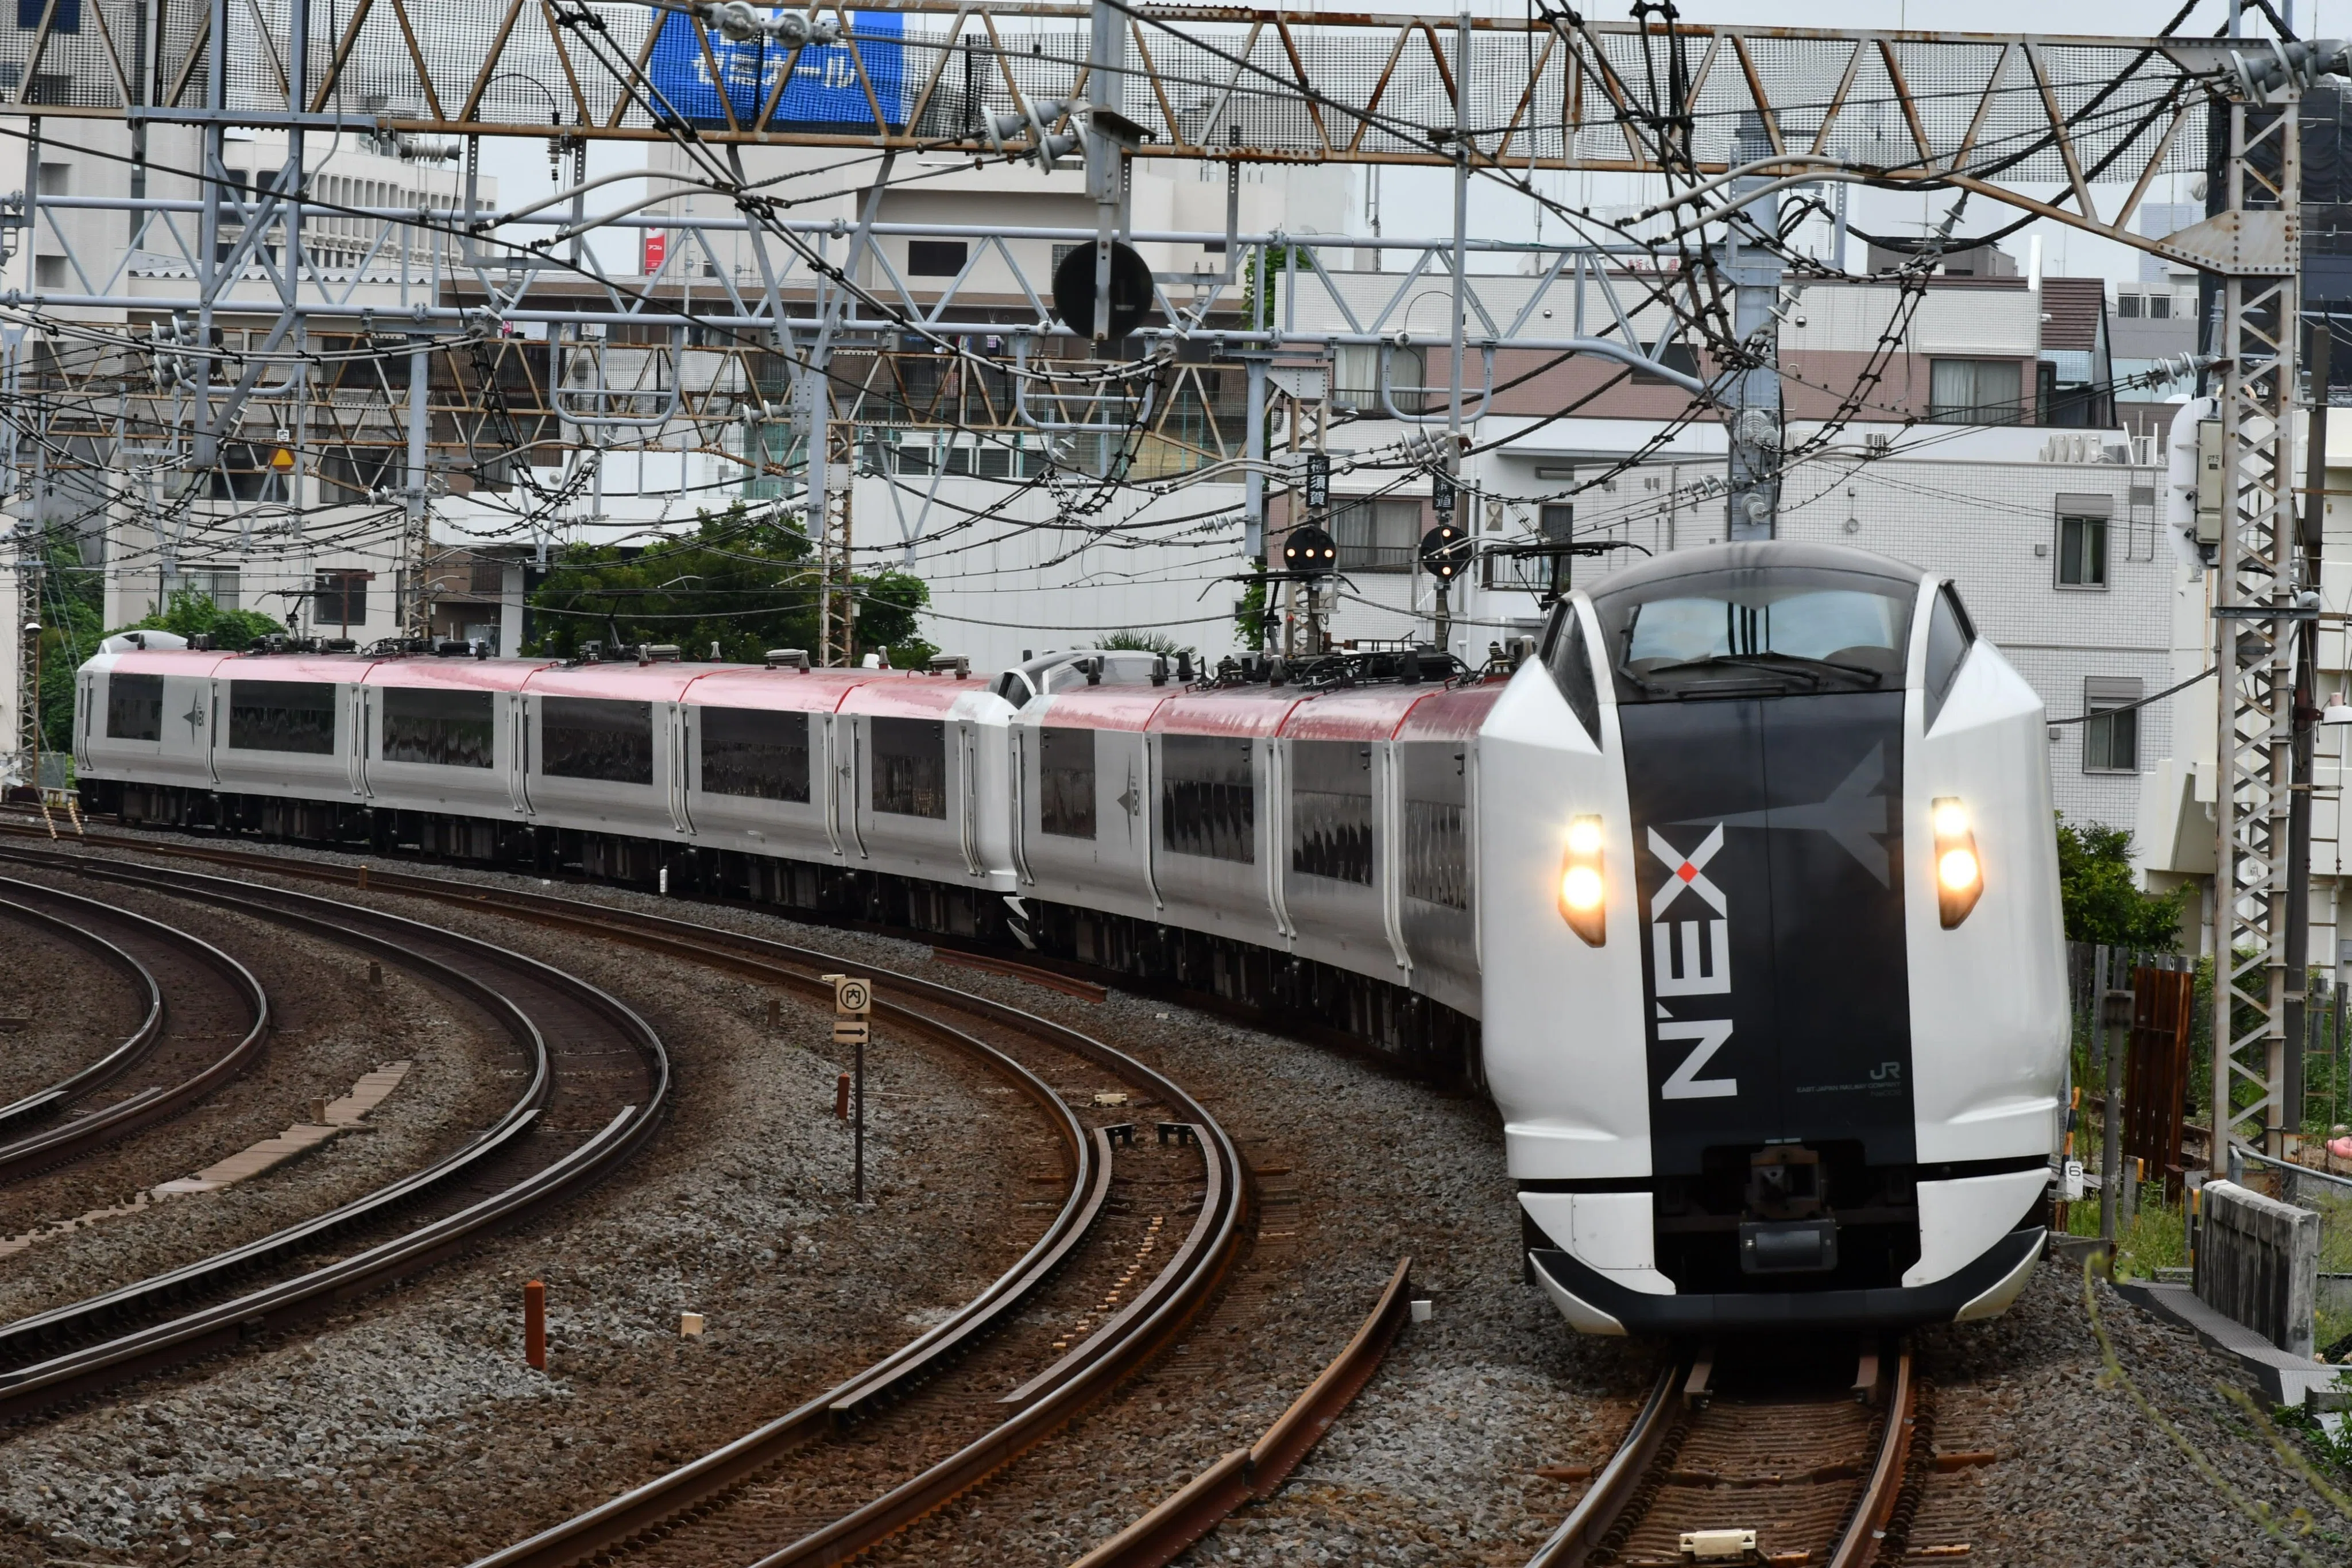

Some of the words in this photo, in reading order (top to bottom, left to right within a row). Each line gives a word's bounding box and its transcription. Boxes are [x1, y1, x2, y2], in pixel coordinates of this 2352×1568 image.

[1870, 1061, 1901, 1080] JR
[1867, 1081, 1901, 1089] COMPANY
[2069, 1166, 2081, 1176] 6
